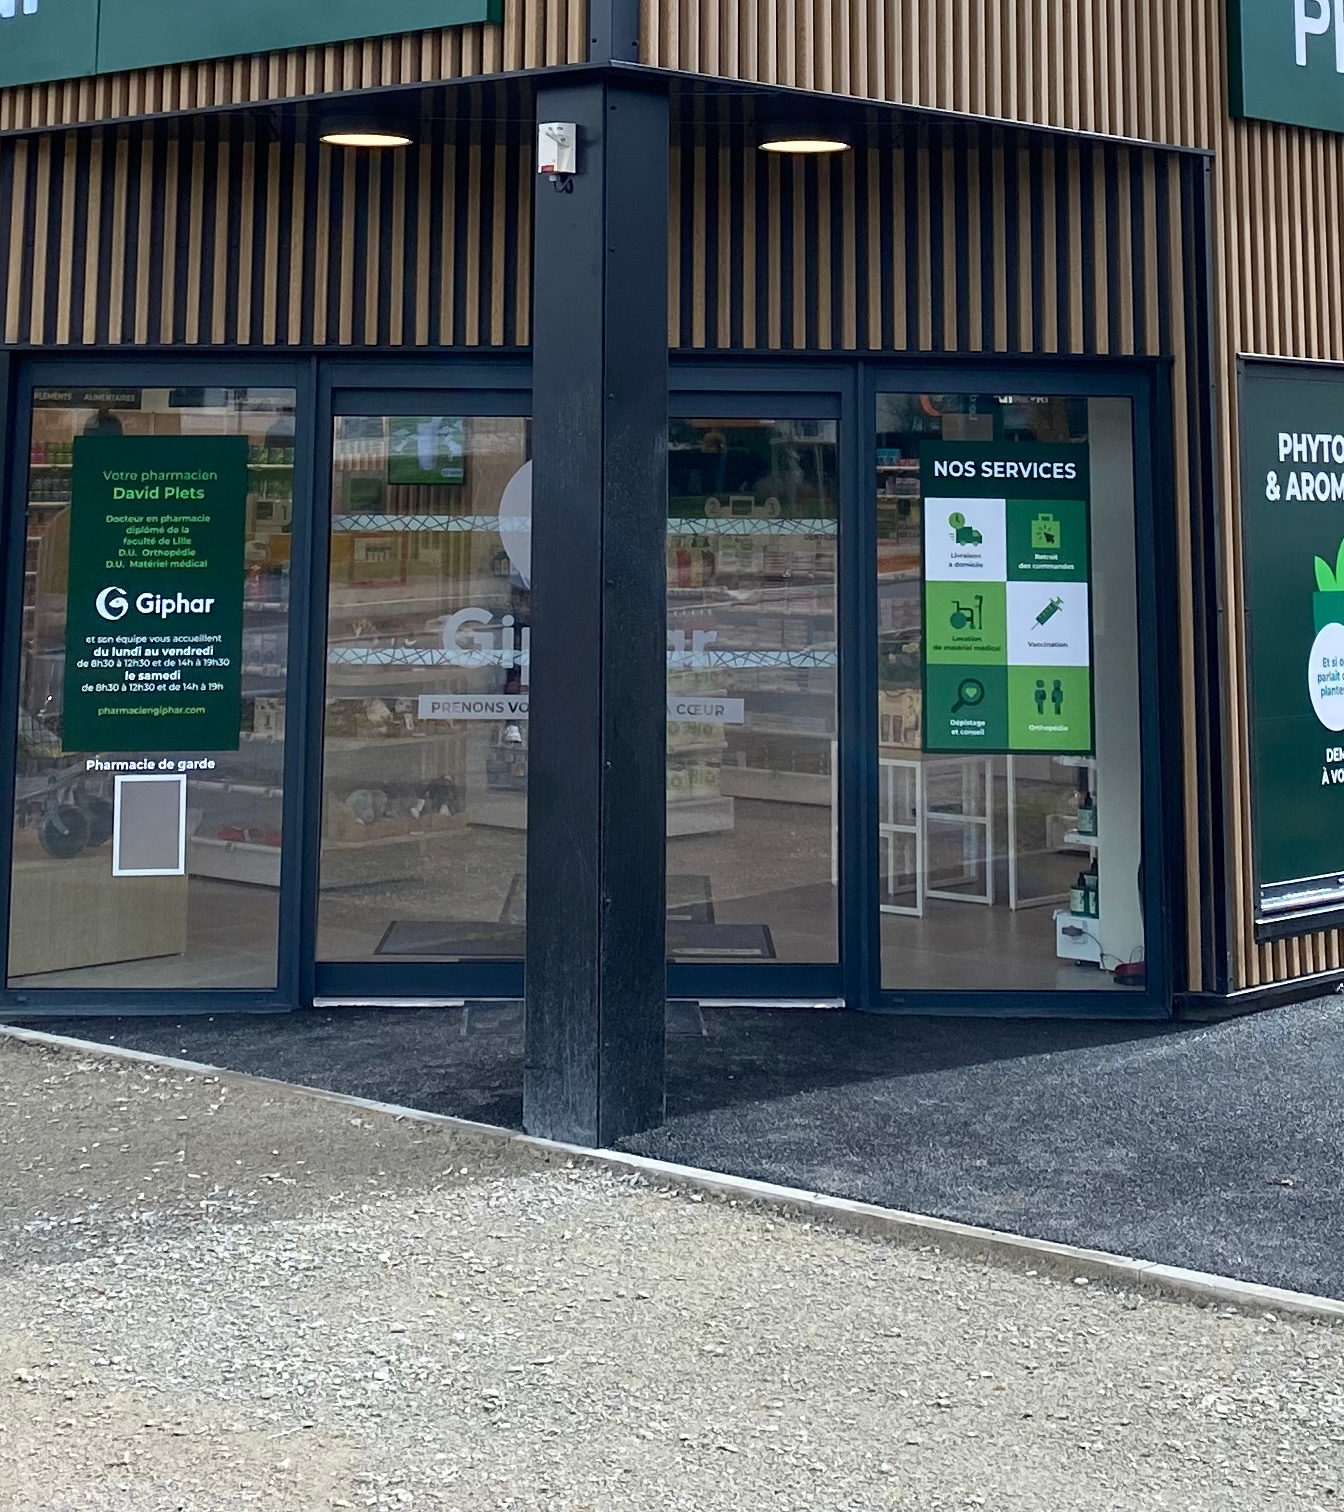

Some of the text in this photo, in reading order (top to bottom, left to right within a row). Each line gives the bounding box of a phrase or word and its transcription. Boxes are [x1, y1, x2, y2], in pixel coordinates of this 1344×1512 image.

[103, 469, 218, 482] Votre pharmacien
[934, 460, 1076, 480] NOS SERVICES
[1266, 471, 1281, 501] &
[113, 486, 205, 500] David Plets
[106, 515, 143, 523] Docteur
[160, 514, 211, 524] pharmacie
[167, 526, 180, 534] de
[181, 525, 190, 533] la
[123, 536, 192, 546] faculté de Lille
[118, 548, 196, 558] D.U. Orthopédie
[106, 558, 208, 568] D.U. Matériel médical
[136, 592, 215, 619] Giphar
[85, 634, 222, 645] et son équipe vous accueillent
[93, 645, 214, 657] du lundi au vendredi
[76, 658, 230, 668] de 8h30 à 12h30 et de 14h à 19h30
[1322, 657, 1330, 668] Et
[1331, 657, 1338, 667] si
[125, 669, 181, 681] le samedi
[1317, 671, 1341, 684] parlait
[81, 684, 94, 692] de
[95, 683, 119, 692] 8h30
[121, 683, 127, 692] à
[129, 683, 155, 692] 12h30
[168, 683, 181, 691] de
[183, 682, 198, 691] 14h
[200, 682, 206, 691] à
[208, 682, 224, 691] 19h
[97, 706, 206, 717] pharmaciengiphar.com
[431, 702, 504, 714] PRENONS
[676, 704, 725, 716] CŒUR
[960, 728, 985, 736] conseil
[86, 758, 216, 772] Pharmacie de garde
[1321, 766, 1330, 785] À
